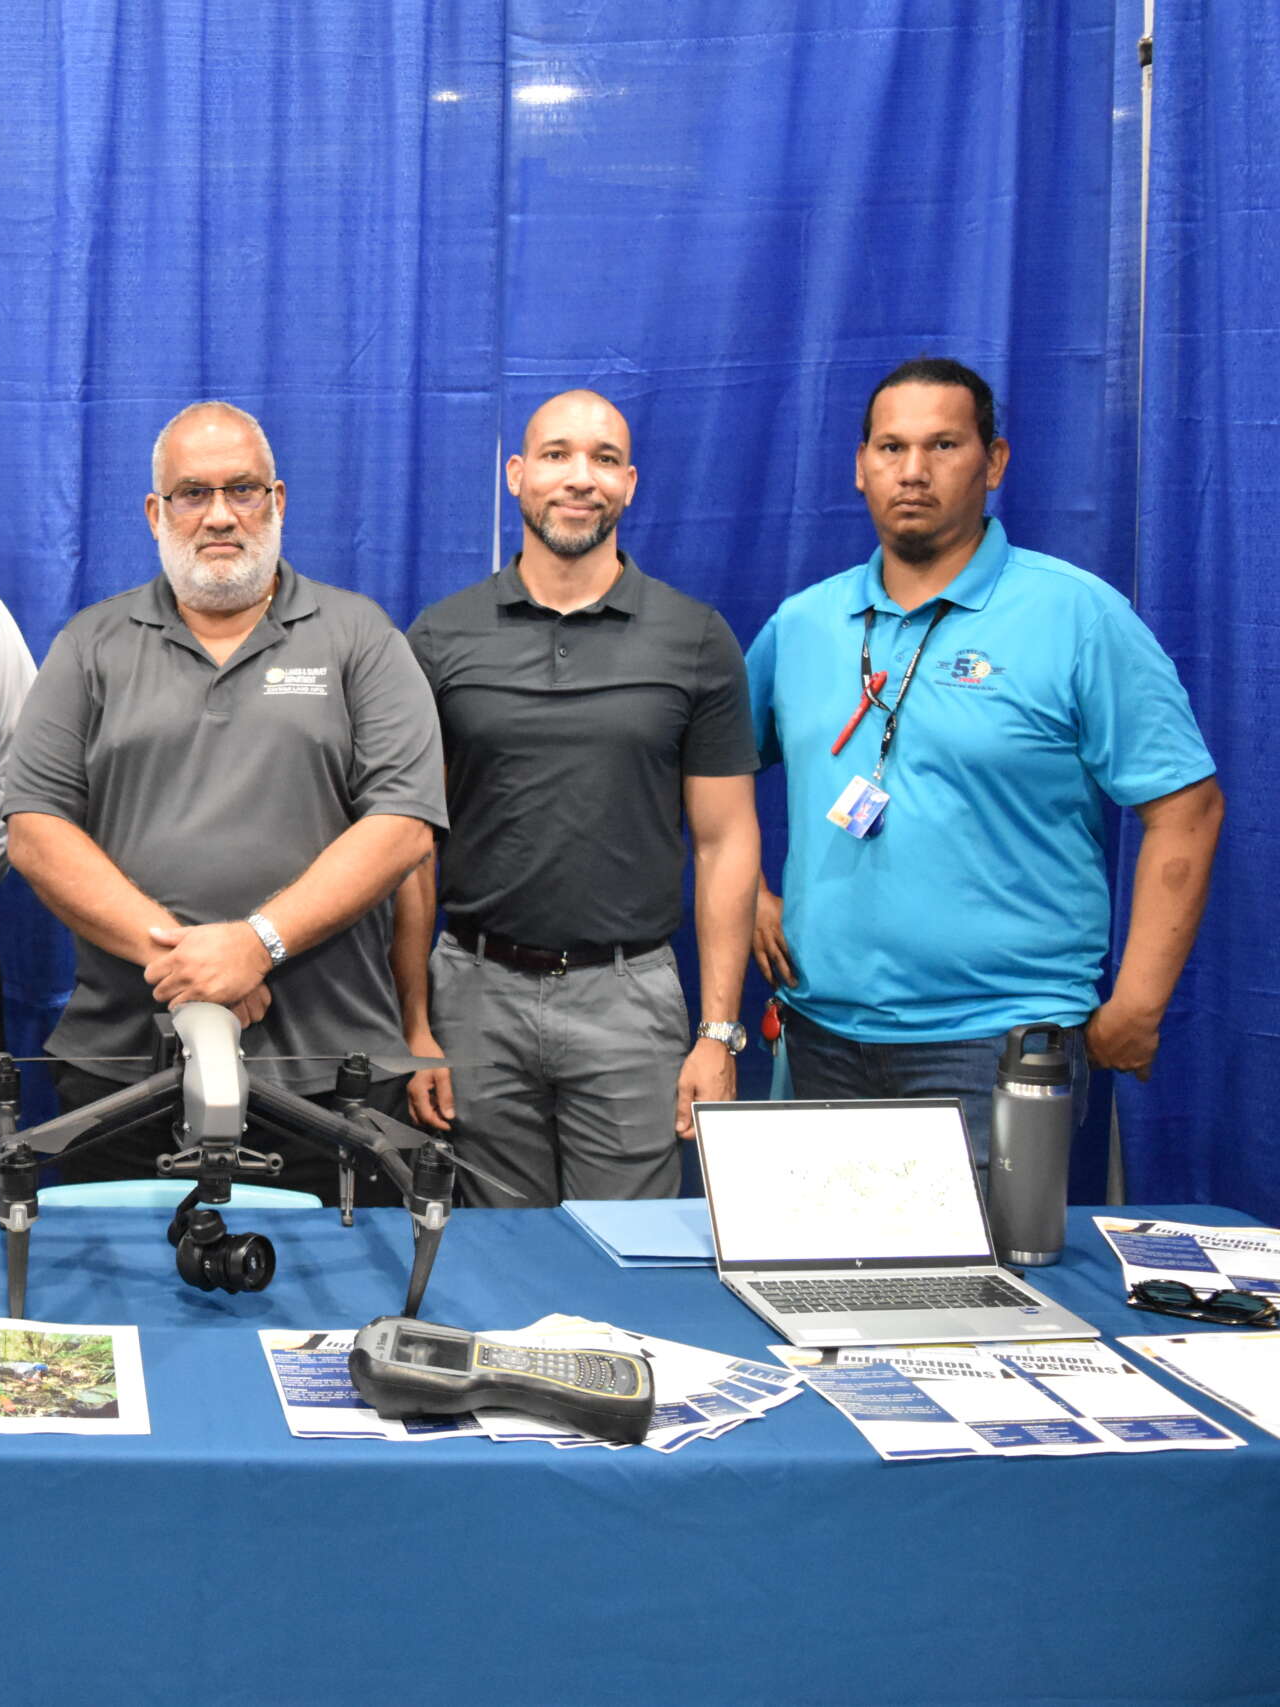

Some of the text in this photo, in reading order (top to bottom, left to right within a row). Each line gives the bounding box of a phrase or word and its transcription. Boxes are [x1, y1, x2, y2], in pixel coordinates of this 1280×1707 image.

[993, 1353, 1094, 1365] ormation
[900, 1366, 996, 1379] systems
[1021, 1362, 1119, 1375] systems
